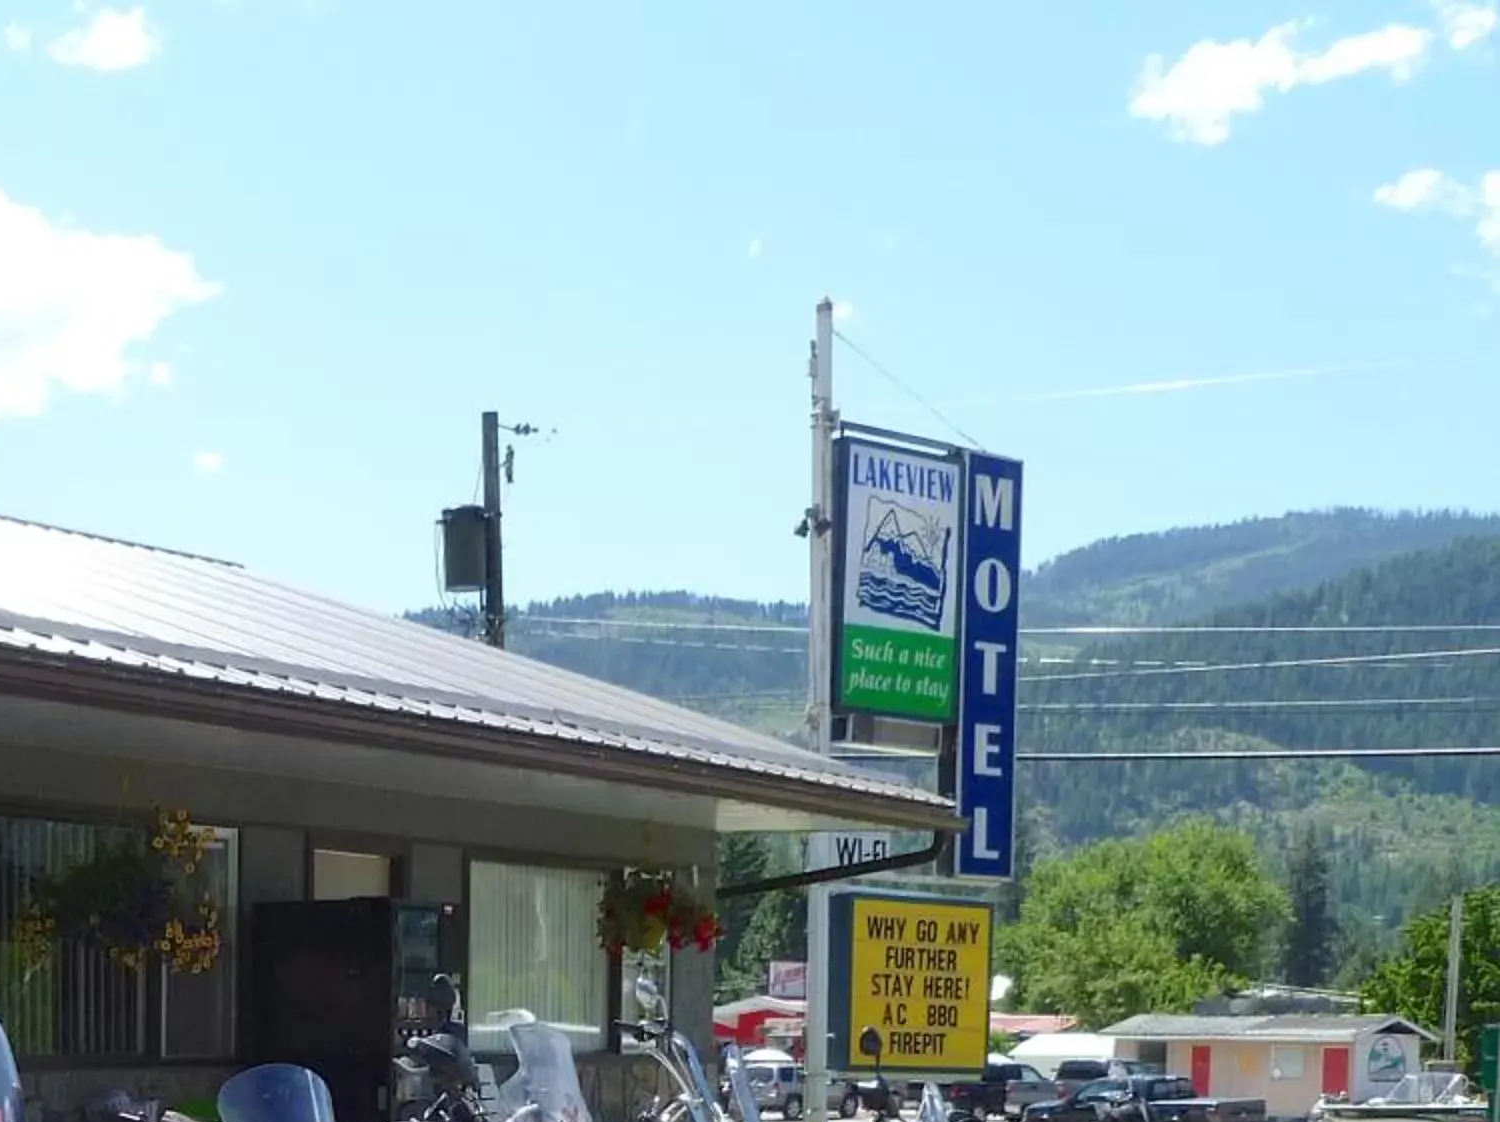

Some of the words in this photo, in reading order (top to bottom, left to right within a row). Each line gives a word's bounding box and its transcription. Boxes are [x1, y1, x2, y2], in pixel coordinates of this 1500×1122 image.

[853, 453, 955, 502] LAKEVIEW
[851, 638, 894, 664] Such
[899, 648, 909, 665] a
[913, 645, 946, 670] nice
[972, 473, 1015, 861] MOTEL
[847, 666, 891, 694] place
[895, 672, 911, 693] to
[915, 675, 950, 704] stay
[867, 916, 907, 940] WHY
[916, 919, 938, 942] GO
[945, 922, 980, 944] ANY
[885, 949, 957, 971] FURTHER
[871, 973, 914, 997] STAY
[923, 977, 970, 1000] HERE!
[927, 1005, 958, 1027] BBQ
[889, 1032, 947, 1055] FIREPIT
